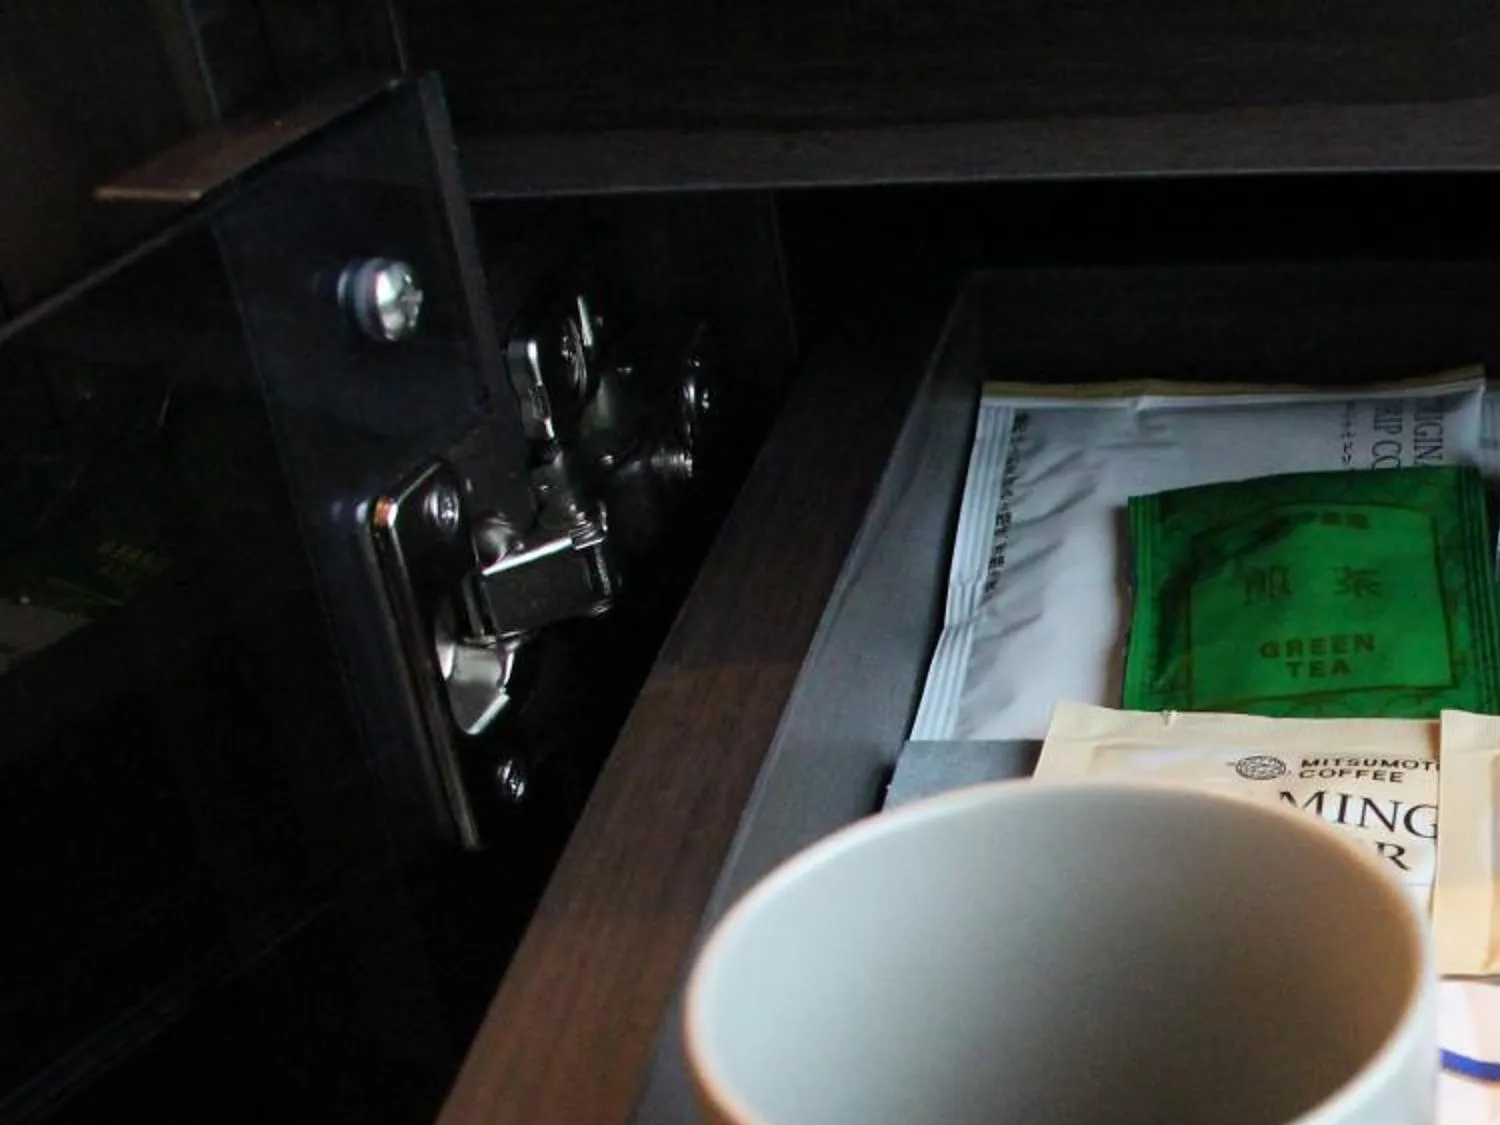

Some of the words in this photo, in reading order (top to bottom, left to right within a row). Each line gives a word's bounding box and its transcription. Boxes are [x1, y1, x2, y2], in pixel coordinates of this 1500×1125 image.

[1259, 633, 1375, 659] GREEN
[1285, 659, 1352, 680] TEA
[1300, 758, 1439, 772] MITSUMOT
[1299, 769, 1405, 783] COFFEE
[1279, 790, 1438, 839] MING
